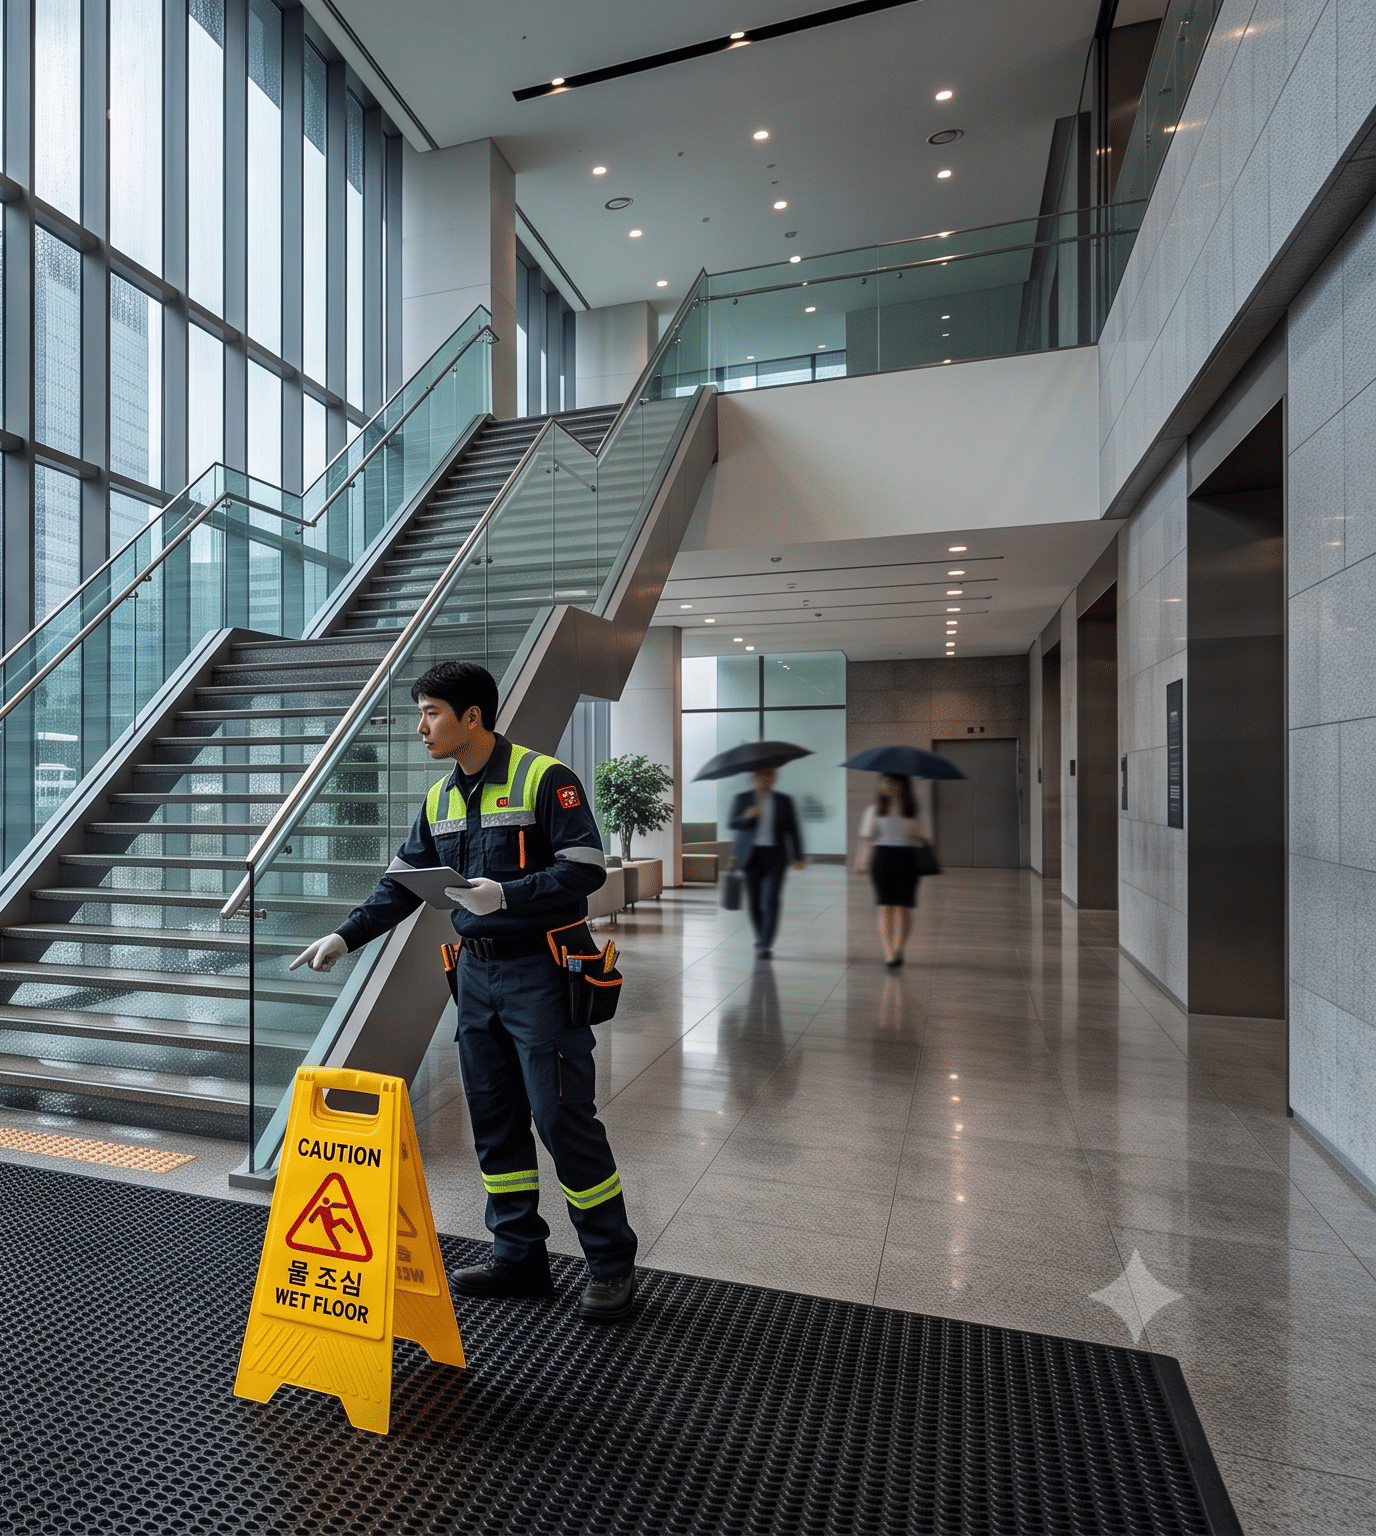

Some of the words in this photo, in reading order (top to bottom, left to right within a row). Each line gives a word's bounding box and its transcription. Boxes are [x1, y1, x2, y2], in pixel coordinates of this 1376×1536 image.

[298, 1137, 382, 1168] CAUTION
[287, 1260, 310, 1287] 물
[314, 1266, 362, 1298] 조심
[275, 1287, 310, 1311] WET
[312, 1295, 369, 1325] FLOOR
